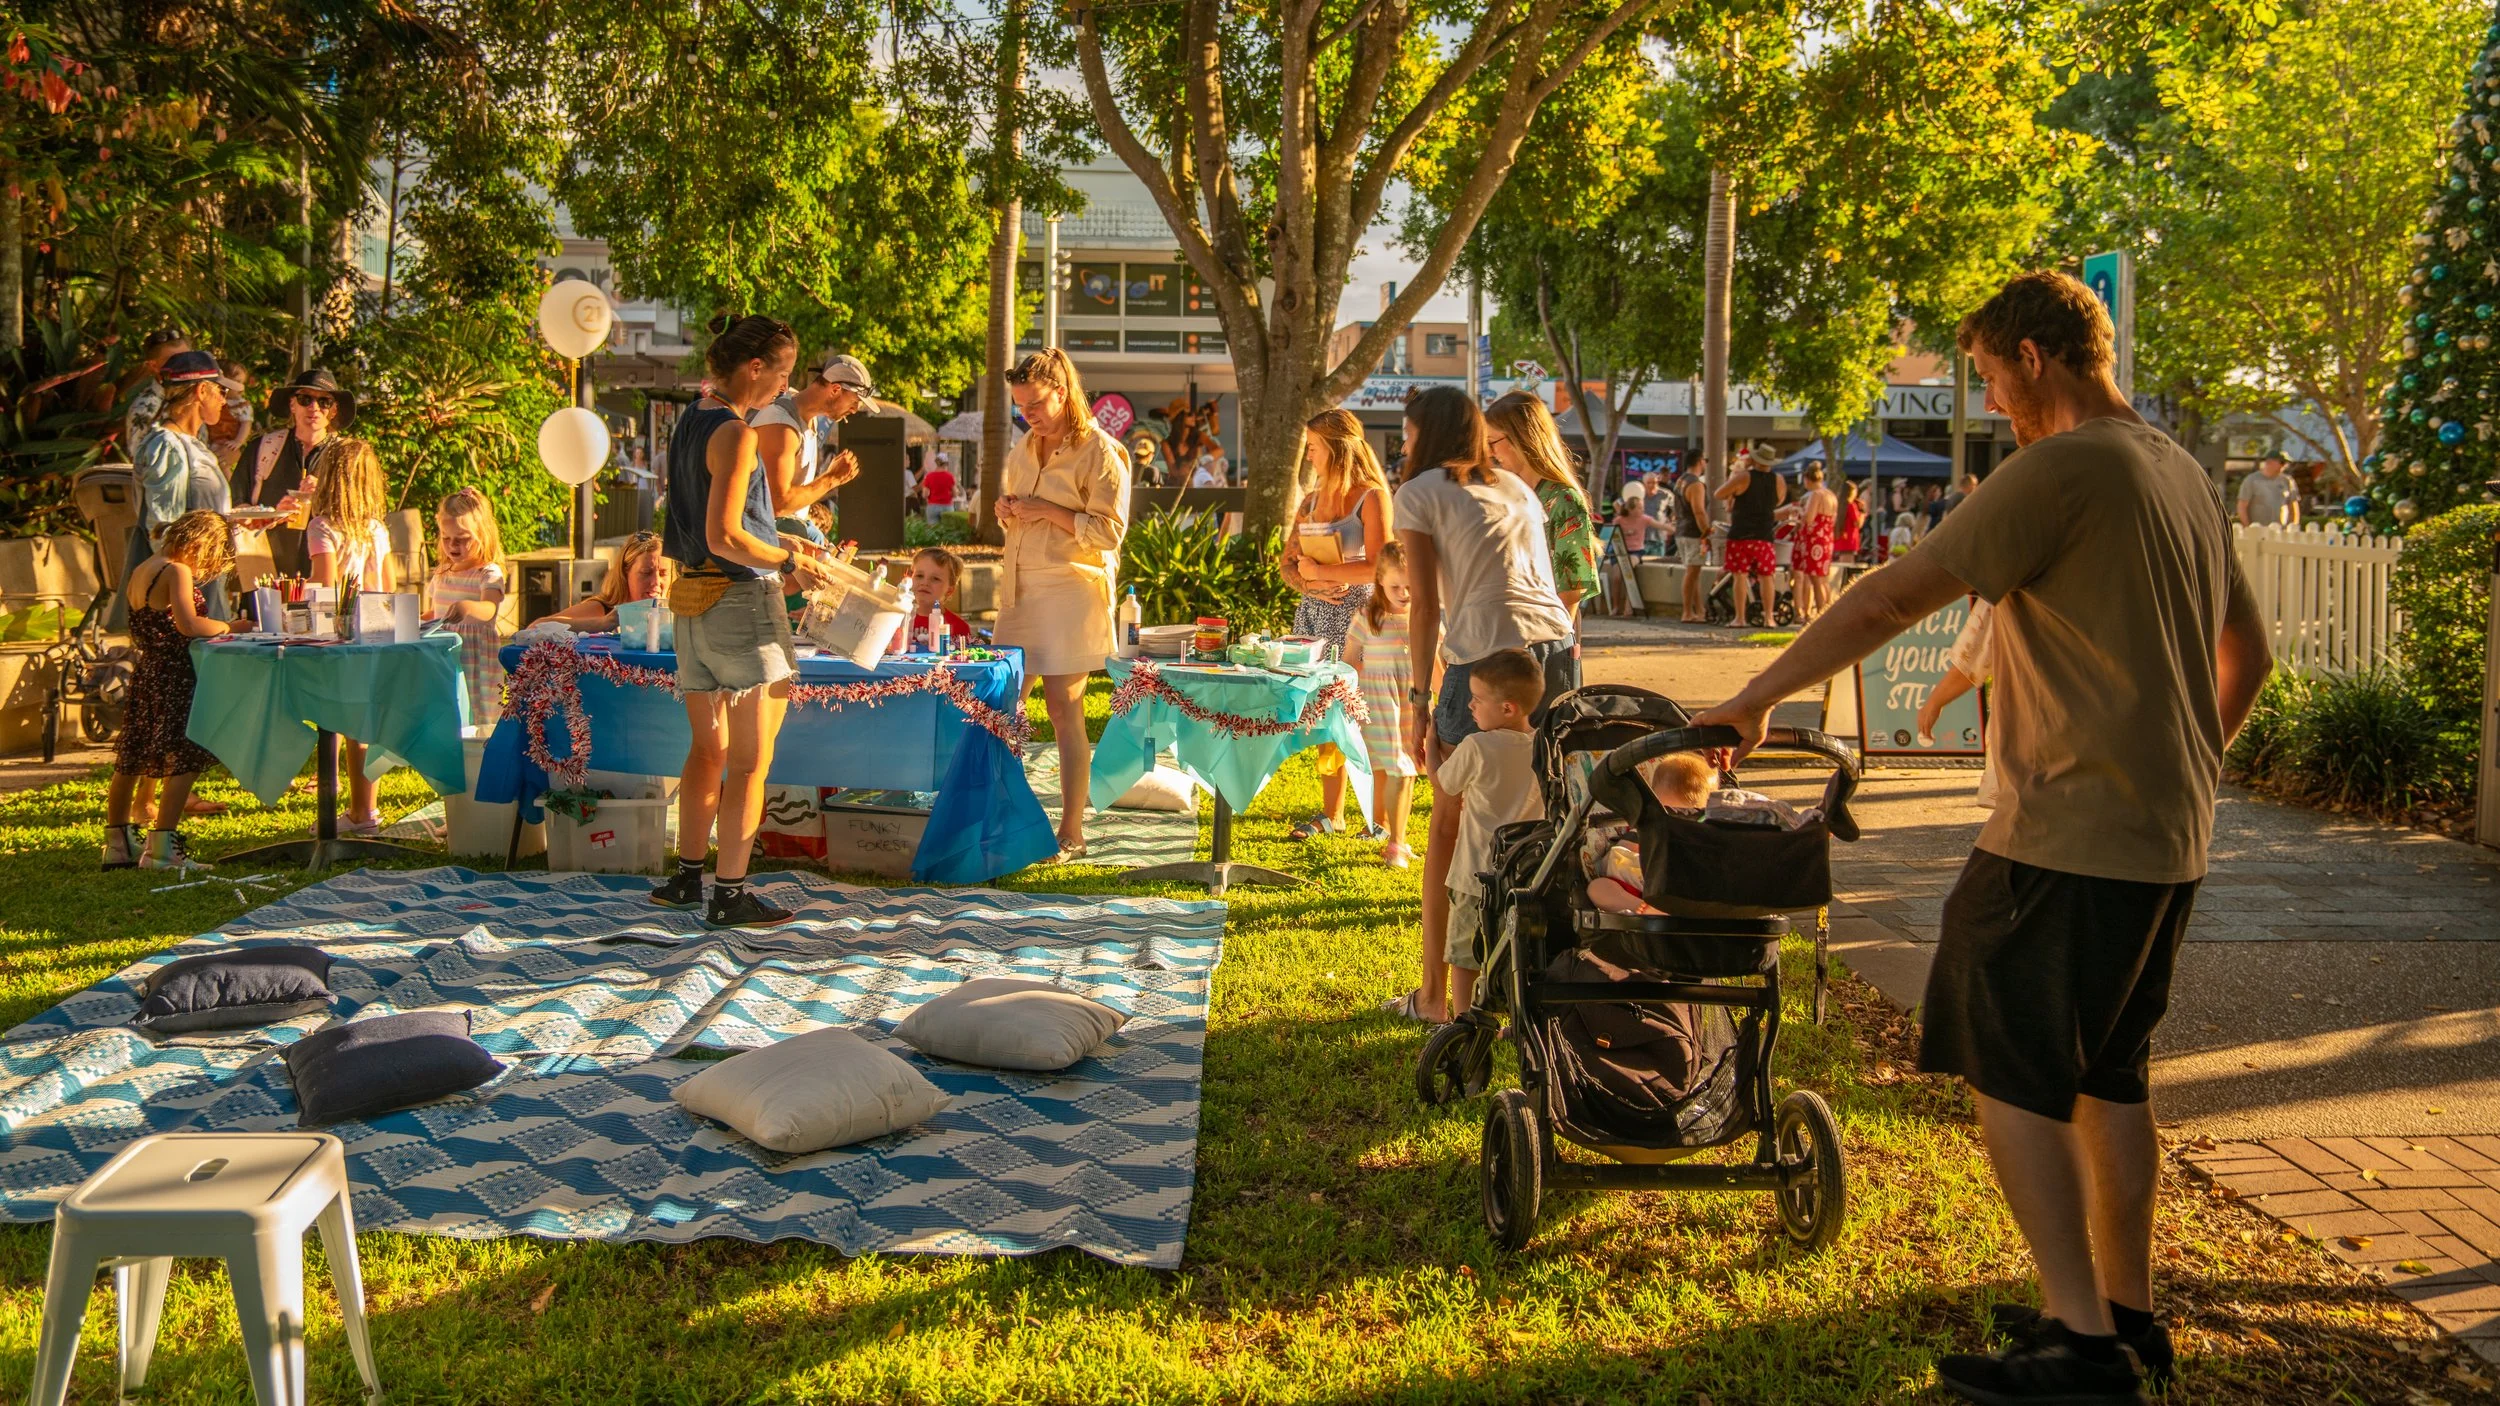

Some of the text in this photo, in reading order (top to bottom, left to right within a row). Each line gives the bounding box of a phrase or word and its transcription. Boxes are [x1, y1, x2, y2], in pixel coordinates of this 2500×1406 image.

[1627, 456, 1679, 473] 2025
[1884, 646, 1954, 682] YOUR
[1886, 682, 1934, 710] STE
[848, 819, 901, 835] FUNKY
[856, 839, 909, 852] FOREST
